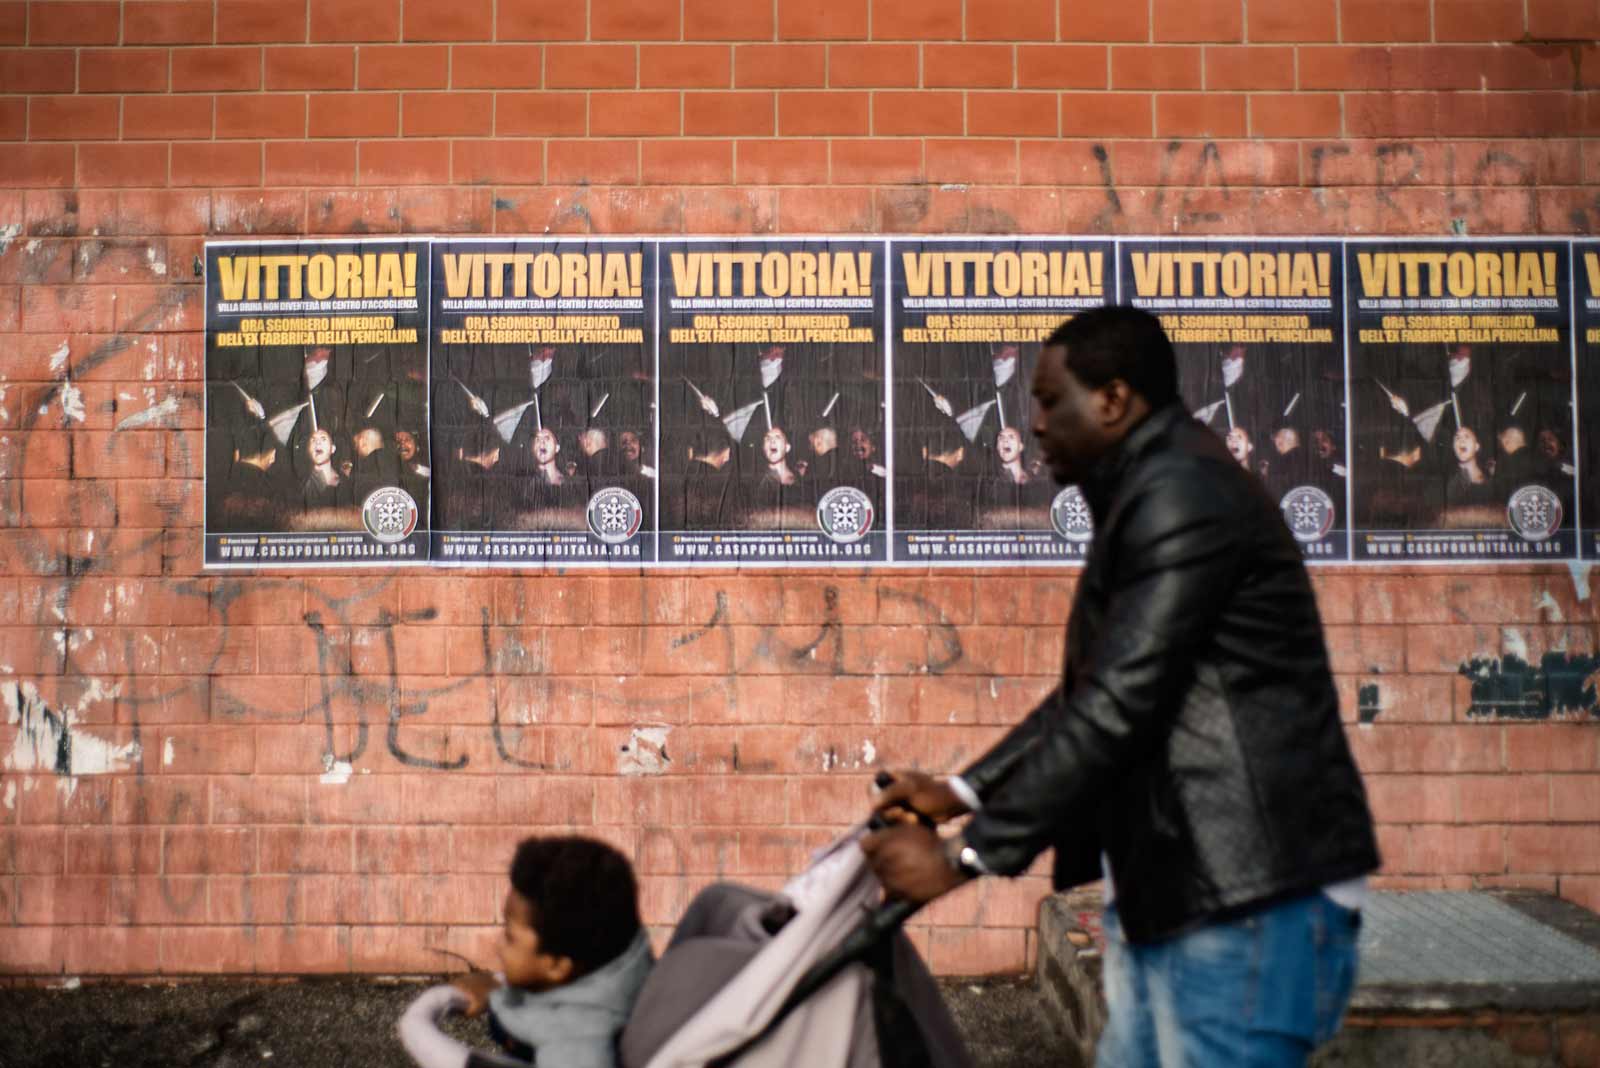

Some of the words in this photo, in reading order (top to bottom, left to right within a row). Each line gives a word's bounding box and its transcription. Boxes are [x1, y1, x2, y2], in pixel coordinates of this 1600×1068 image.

[218, 253, 417, 300] VITTORIA!
[443, 252, 642, 298] VITTORIA!
[670, 252, 872, 297] VITTORIA!
[902, 252, 1103, 296] VITTORIA!
[1131, 252, 1331, 297] VITTORIA!
[1357, 252, 1556, 297] VITTORIA!
[218, 303, 238, 312] VILLA
[263, 302, 280, 311] NON
[281, 300, 320, 310] DIVENTERÀ
[332, 301, 361, 310] CENTRO
[362, 300, 418, 309] D'ACCOGLIENZA
[442, 300, 463, 309] VILLA
[488, 300, 504, 309] NON
[505, 298, 544, 309] DIVENTERÀ
[557, 300, 586, 309] CENTRO
[587, 300, 643, 309] D'ACCOGLIENZA
[670, 299, 691, 308] VILLA
[716, 299, 732, 308] NON
[733, 298, 773, 308] DIVENTERÀ
[786, 299, 815, 308] CENTRO
[816, 299, 873, 308] D'ACCOGLIENZA
[902, 298, 923, 308] VILLA
[949, 298, 964, 308] NON
[965, 297, 1005, 308] DIVENTERÀ
[1018, 298, 1046, 308] CENTRO
[1194, 298, 1233, 308] DIVENTERÀ
[1246, 298, 1275, 308] CENTRO
[1358, 299, 1379, 308] VILLA
[1420, 298, 1460, 308] DIVENTERÀ
[1472, 299, 1501, 308] CENTRO
[1502, 299, 1558, 308] D'ACCOGLIENZA
[240, 319, 264, 332] ORA
[266, 318, 329, 332] SGOMBERO
[331, 316, 394, 330] IMMEDIATO
[466, 317, 489, 330] ORA
[490, 317, 553, 330] SGOMBERO
[556, 316, 619, 329] IMMEDIATO
[694, 316, 719, 329] ORA
[720, 316, 783, 329] SGOMBERO
[784, 315, 849, 329] IMMEDIATO
[926, 315, 950, 328] ORA
[952, 315, 1015, 328] SGOMBERO
[1017, 315, 1073, 328] IMMEDI
[1181, 316, 1243, 329] SGOMBERO
[1246, 315, 1309, 329] IMMEDIATO
[1382, 316, 1406, 329] ORA
[1408, 316, 1470, 329] SGOMBERO
[1471, 316, 1535, 328] IMMEDIATO
[217, 332, 258, 346] DELL'EX
[260, 331, 315, 345] FABBRICA
[316, 330, 350, 344] DELLA
[351, 329, 417, 343] PENICILLINA
[442, 329, 482, 344] DELL'EX
[484, 329, 540, 344] FABBRICA
[541, 329, 574, 343] DELLA
[576, 329, 643, 343] PENICILLINA
[670, 329, 712, 343] DELL'EX
[713, 329, 769, 343] FABBRICA
[771, 329, 804, 343] DELLA
[805, 328, 873, 343] PENICILLINA
[903, 328, 945, 342] DELL'EX
[946, 328, 1002, 342] FABBRICA
[1003, 328, 1036, 342] DELLA
[1175, 329, 1230, 342] FABBRICA
[1231, 329, 1264, 342] DELLA
[1266, 329, 1332, 342] PENICILLINA
[1359, 329, 1400, 343] DELL'EX
[1401, 329, 1456, 343] FABBRICA
[1459, 329, 1491, 342] DELLA
[1492, 329, 1558, 342] PENICILLINA
[220, 544, 416, 557] WWW.CASAPOUNDITALIA.ORG
[443, 544, 640, 555] WWW.CASAPOUNDITALIA.ORG
[674, 544, 871, 555] WWW.CASAPOUNDITALIA.ORG
[908, 543, 1086, 554] WWW.CASAPOUNDITALIA.O
[1366, 542, 1560, 554] WWW.CASAPOUNDITALIA.ORG
